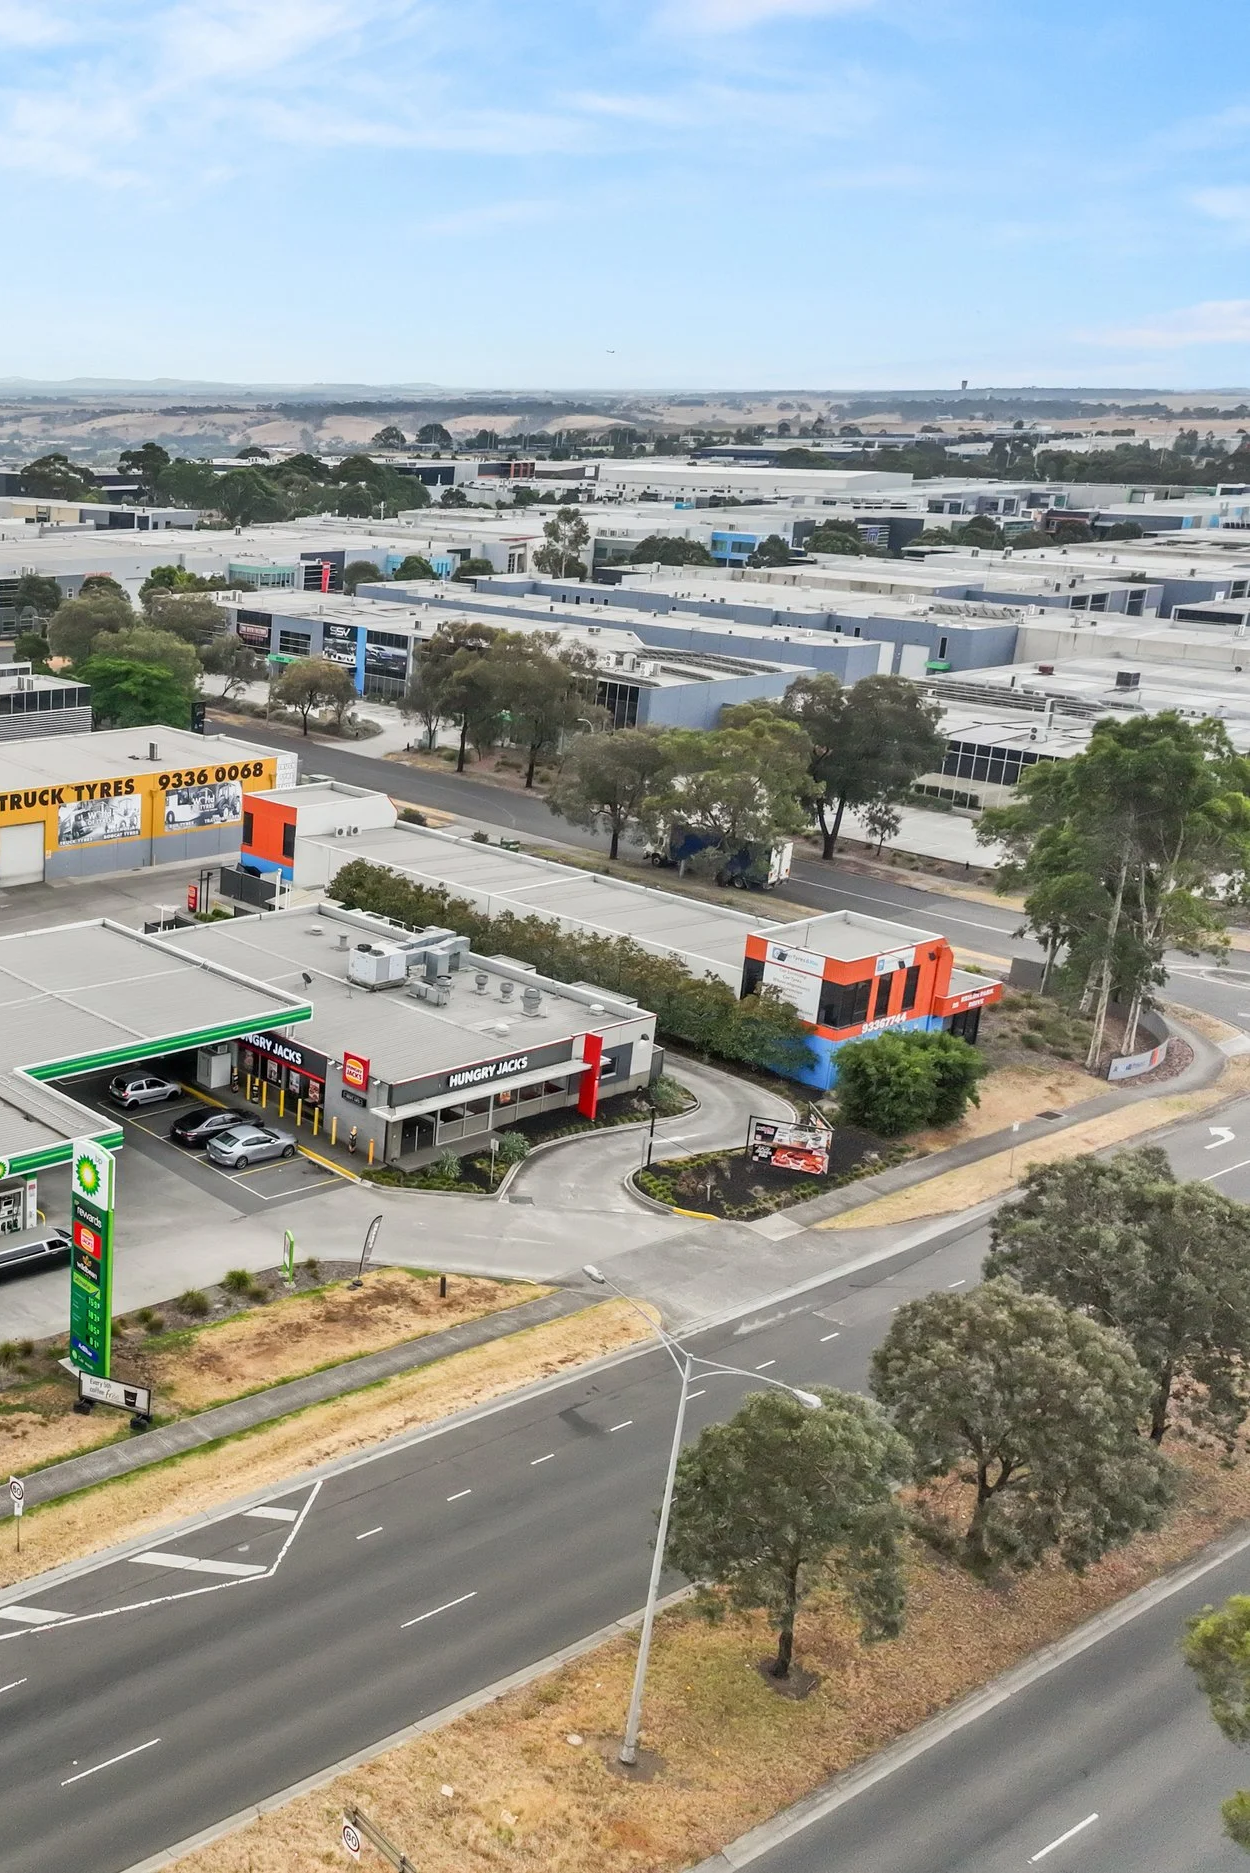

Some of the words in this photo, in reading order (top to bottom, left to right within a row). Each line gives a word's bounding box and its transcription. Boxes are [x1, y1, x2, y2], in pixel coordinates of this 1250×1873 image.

[329, 626, 351, 637] SSV
[158, 769, 209, 791] 9336
[214, 762, 263, 782] 0068
[74, 779, 135, 801] TYRES
[861, 1012, 907, 1033] 93367744
[346, 1064, 363, 1073] HUNGRY
[449, 1065, 496, 1087] HUNGRY
[76, 1206, 102, 1229] rewards
[78, 1342, 92, 1357] AdBlue
[90, 1378, 103, 1388] Every
[90, 1387, 105, 1395] coffee
[346, 1830, 357, 1847] 80
